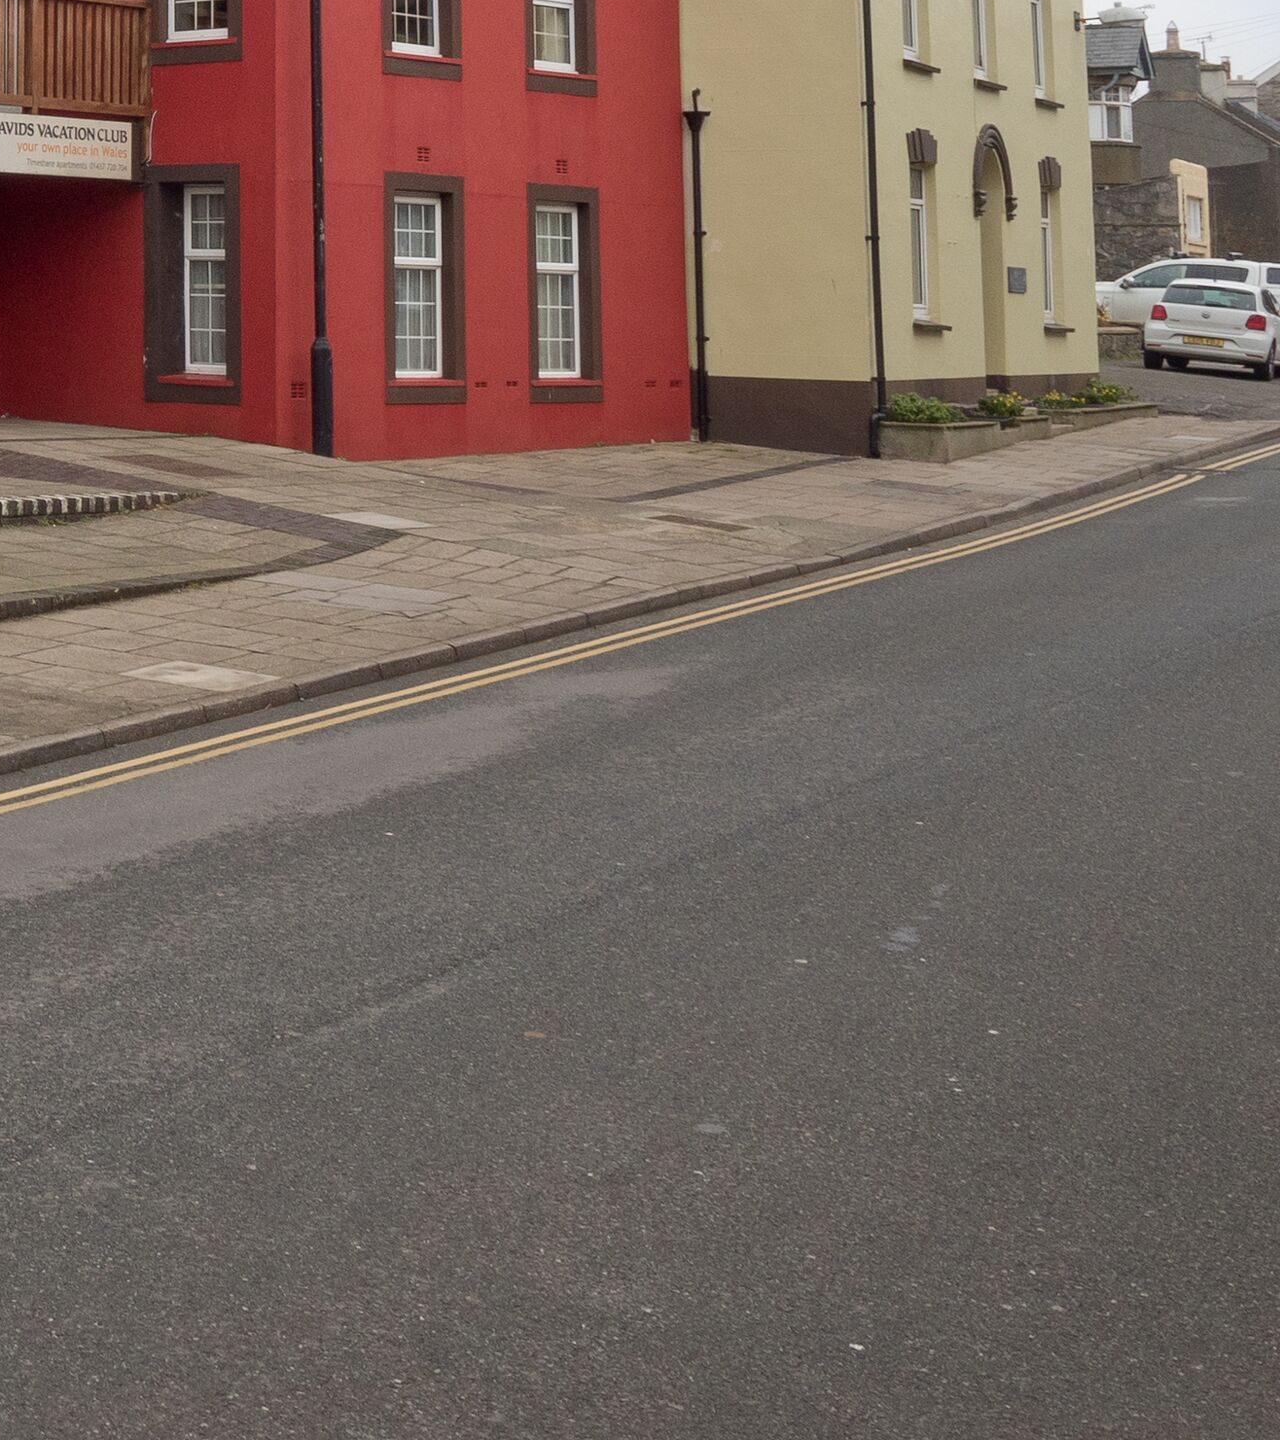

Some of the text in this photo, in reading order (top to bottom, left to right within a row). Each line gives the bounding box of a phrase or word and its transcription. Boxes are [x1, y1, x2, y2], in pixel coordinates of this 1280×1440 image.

[37, 124, 96, 141] VACATION
[97, 128, 128, 143] CLUB
[17, 142, 128, 158] your own place in Wales
